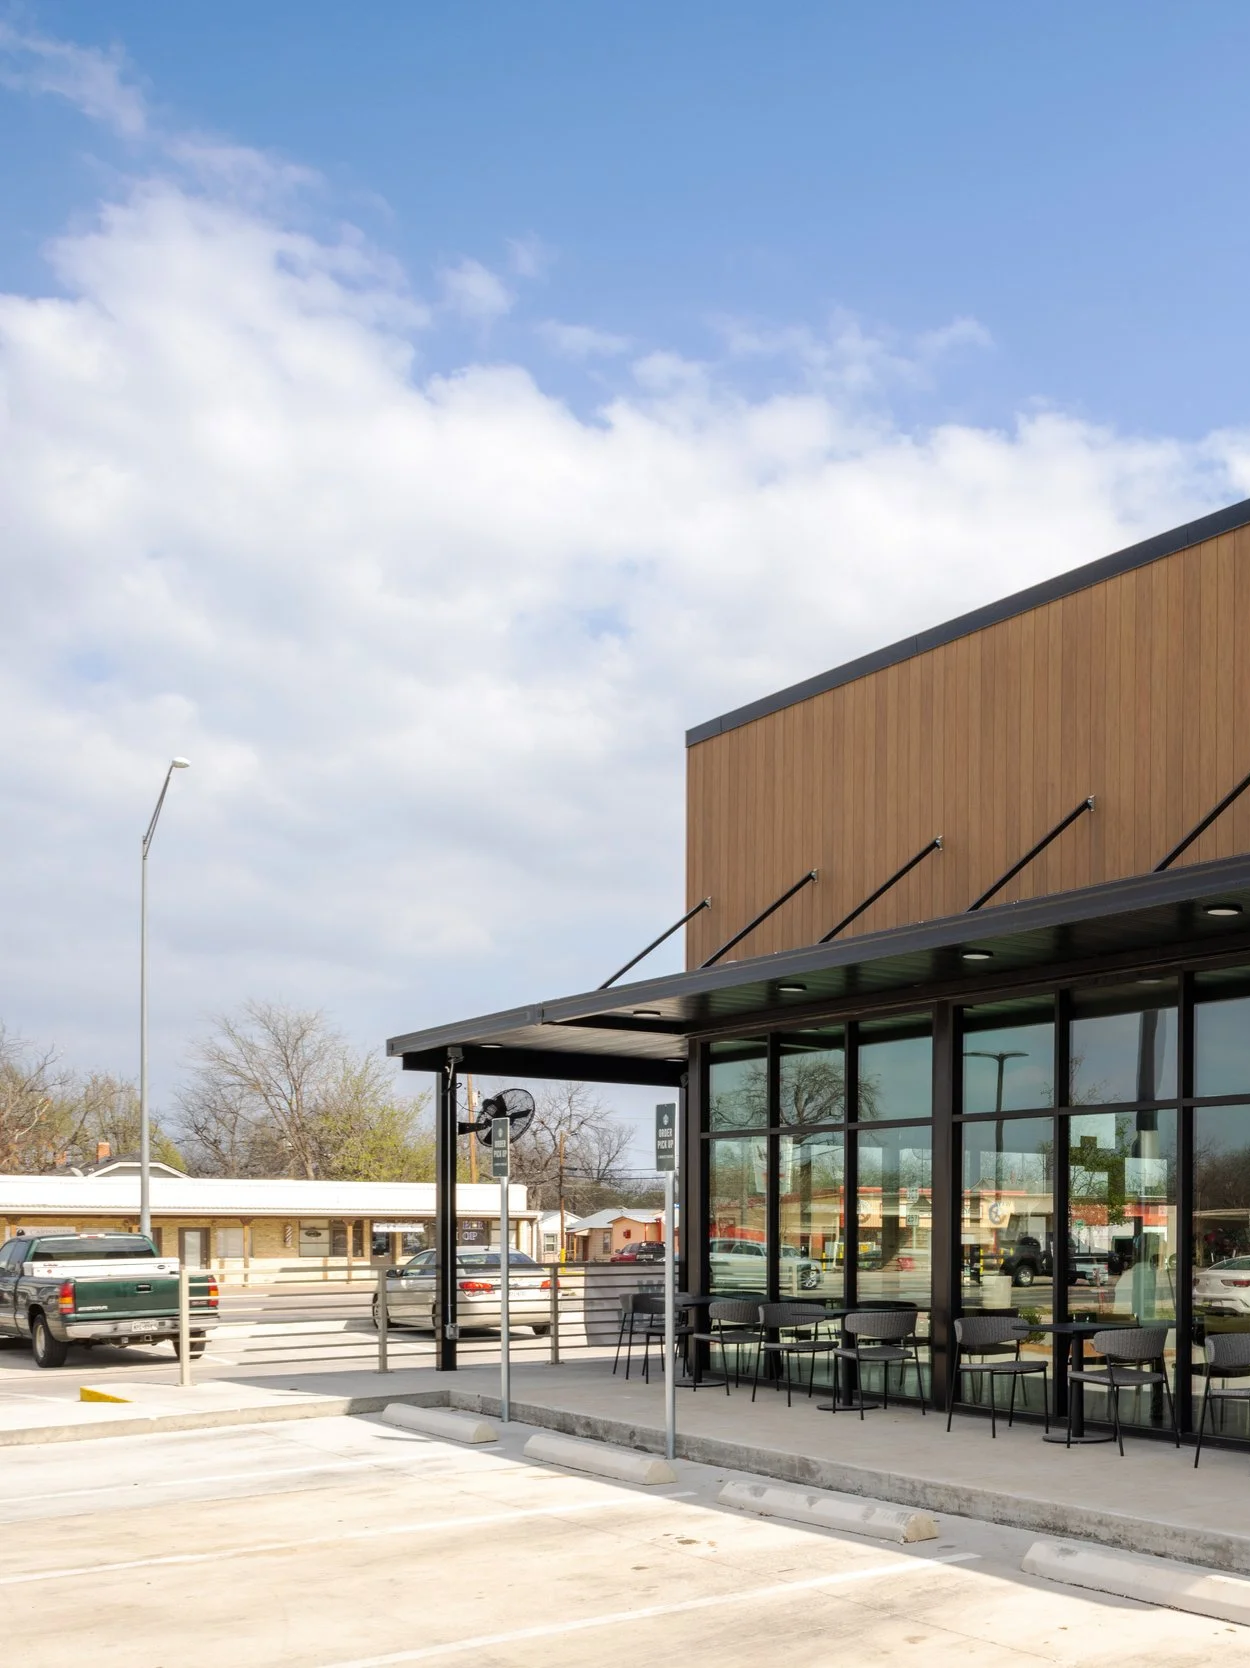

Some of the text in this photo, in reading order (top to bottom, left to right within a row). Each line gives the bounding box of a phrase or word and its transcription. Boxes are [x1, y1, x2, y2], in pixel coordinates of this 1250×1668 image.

[658, 1128, 673, 1138] ORDER
[657, 1139, 674, 1150] PICK UP
